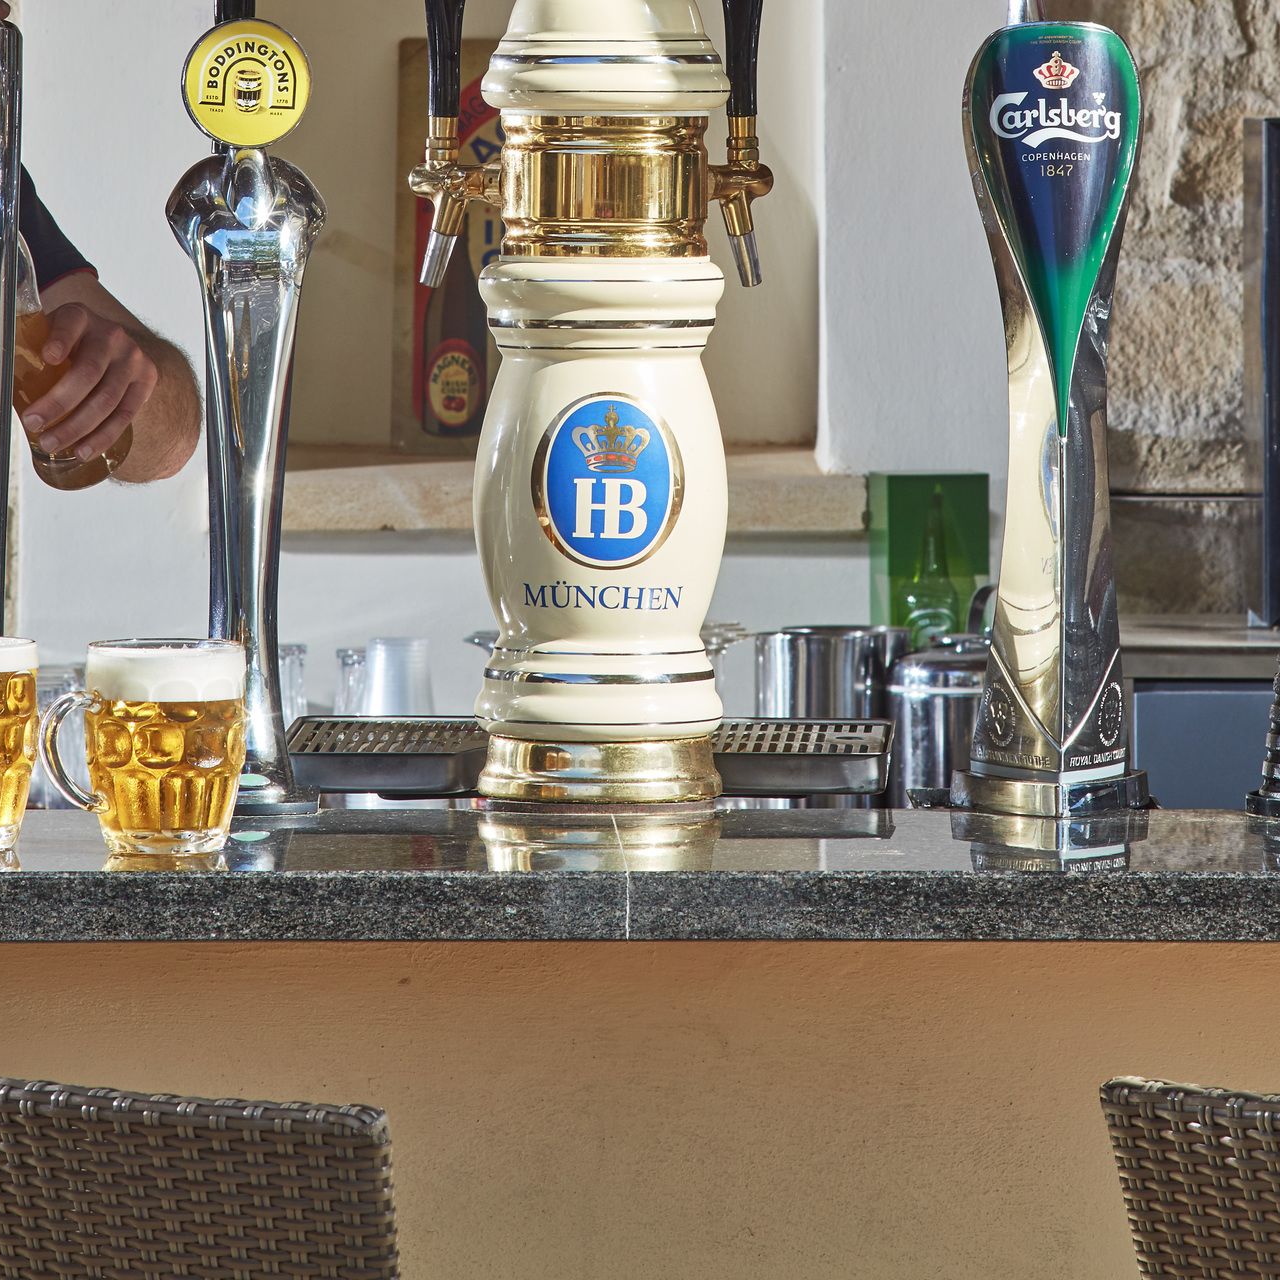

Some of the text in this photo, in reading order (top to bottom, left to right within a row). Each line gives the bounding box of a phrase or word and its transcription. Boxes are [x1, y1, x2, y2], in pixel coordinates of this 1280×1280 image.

[206, 41, 289, 93] BODDINGTONS
[989, 91, 1121, 146] Carlsberg
[1021, 152, 1091, 162] COPENHAGEN
[1040, 164, 1074, 177] 1847
[572, 478, 648, 539] HB
[522, 581, 683, 611] MÜNCHEN
[1069, 756, 1092, 767] ROYAL
[1093, 752, 1113, 765] DANISH
